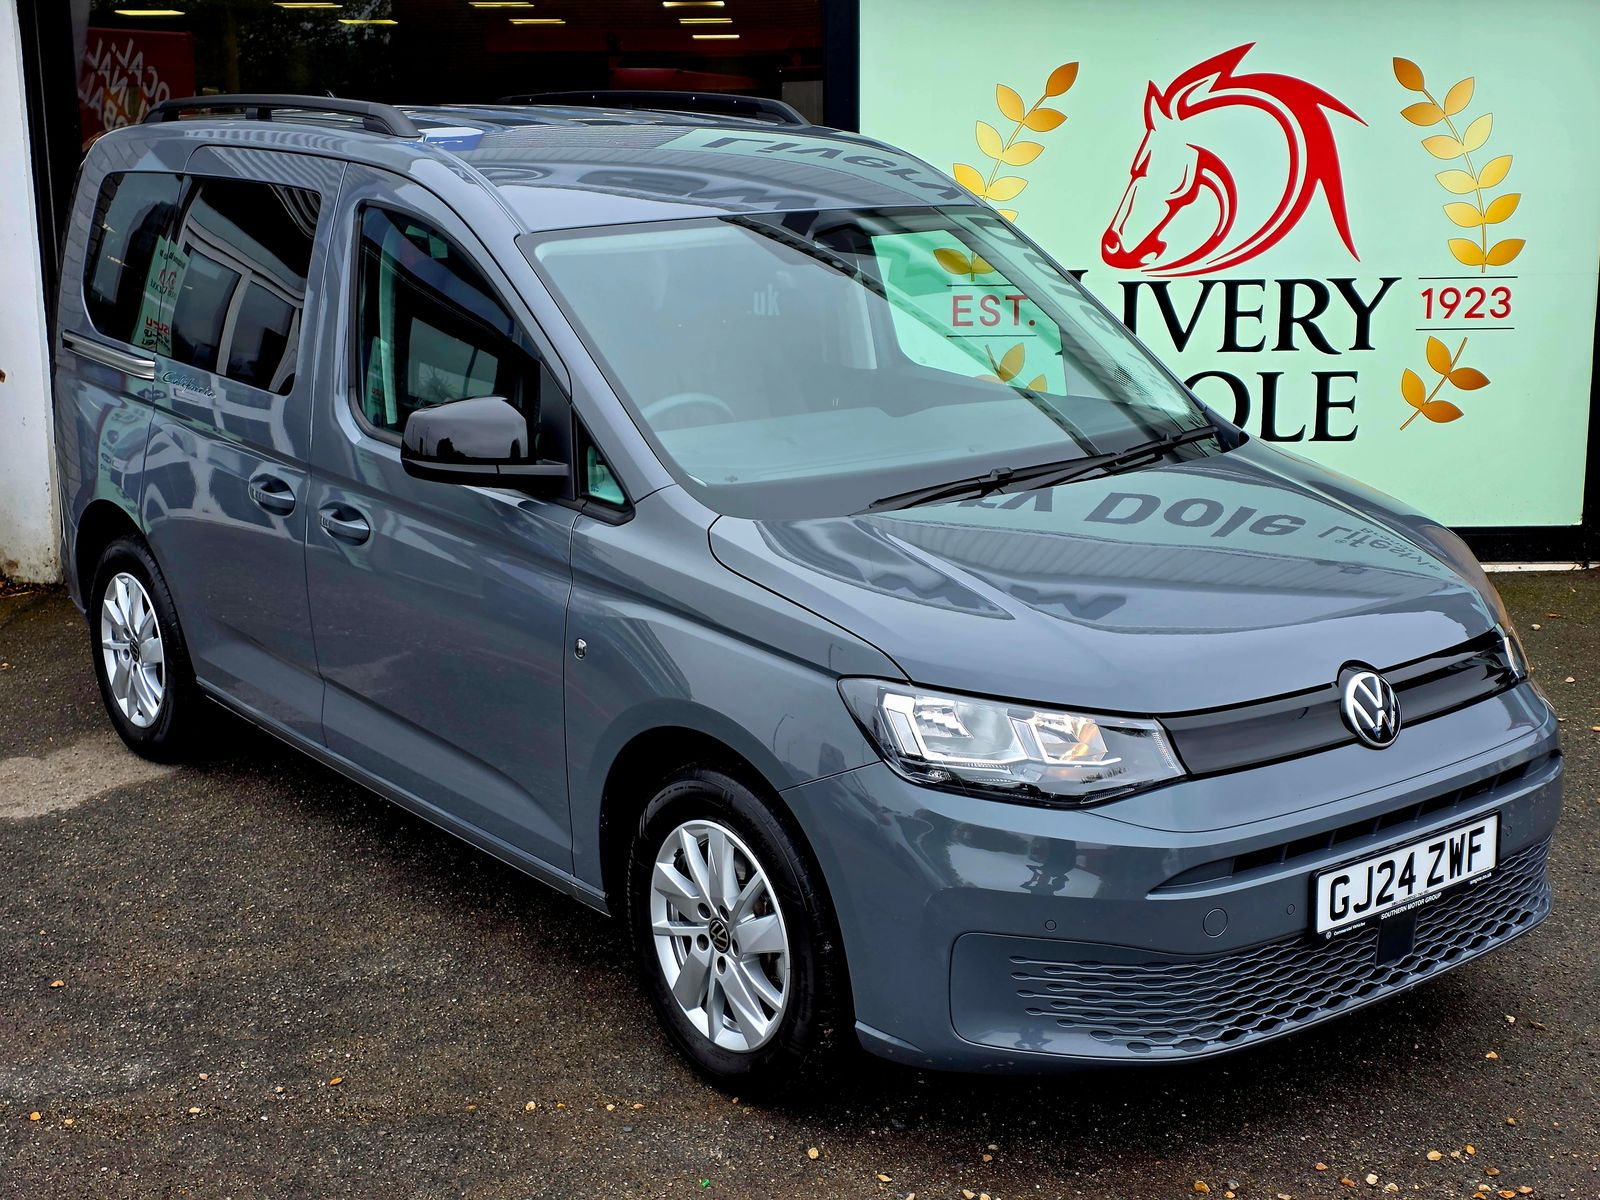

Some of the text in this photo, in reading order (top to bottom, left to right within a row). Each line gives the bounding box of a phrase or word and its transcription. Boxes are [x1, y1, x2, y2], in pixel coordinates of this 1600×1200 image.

[952, 294, 1037, 327] EST.
[1068, 269, 1402, 355] IVERY
[1420, 286, 1514, 321] 1923
[1183, 369, 1359, 443] OLE
[1329, 825, 1486, 922] GJ24 ZWF
[1380, 904, 1408, 920] SOUTHERN
[1407, 899, 1425, 911] MOTOR
[1424, 891, 1443, 905] GROUP
